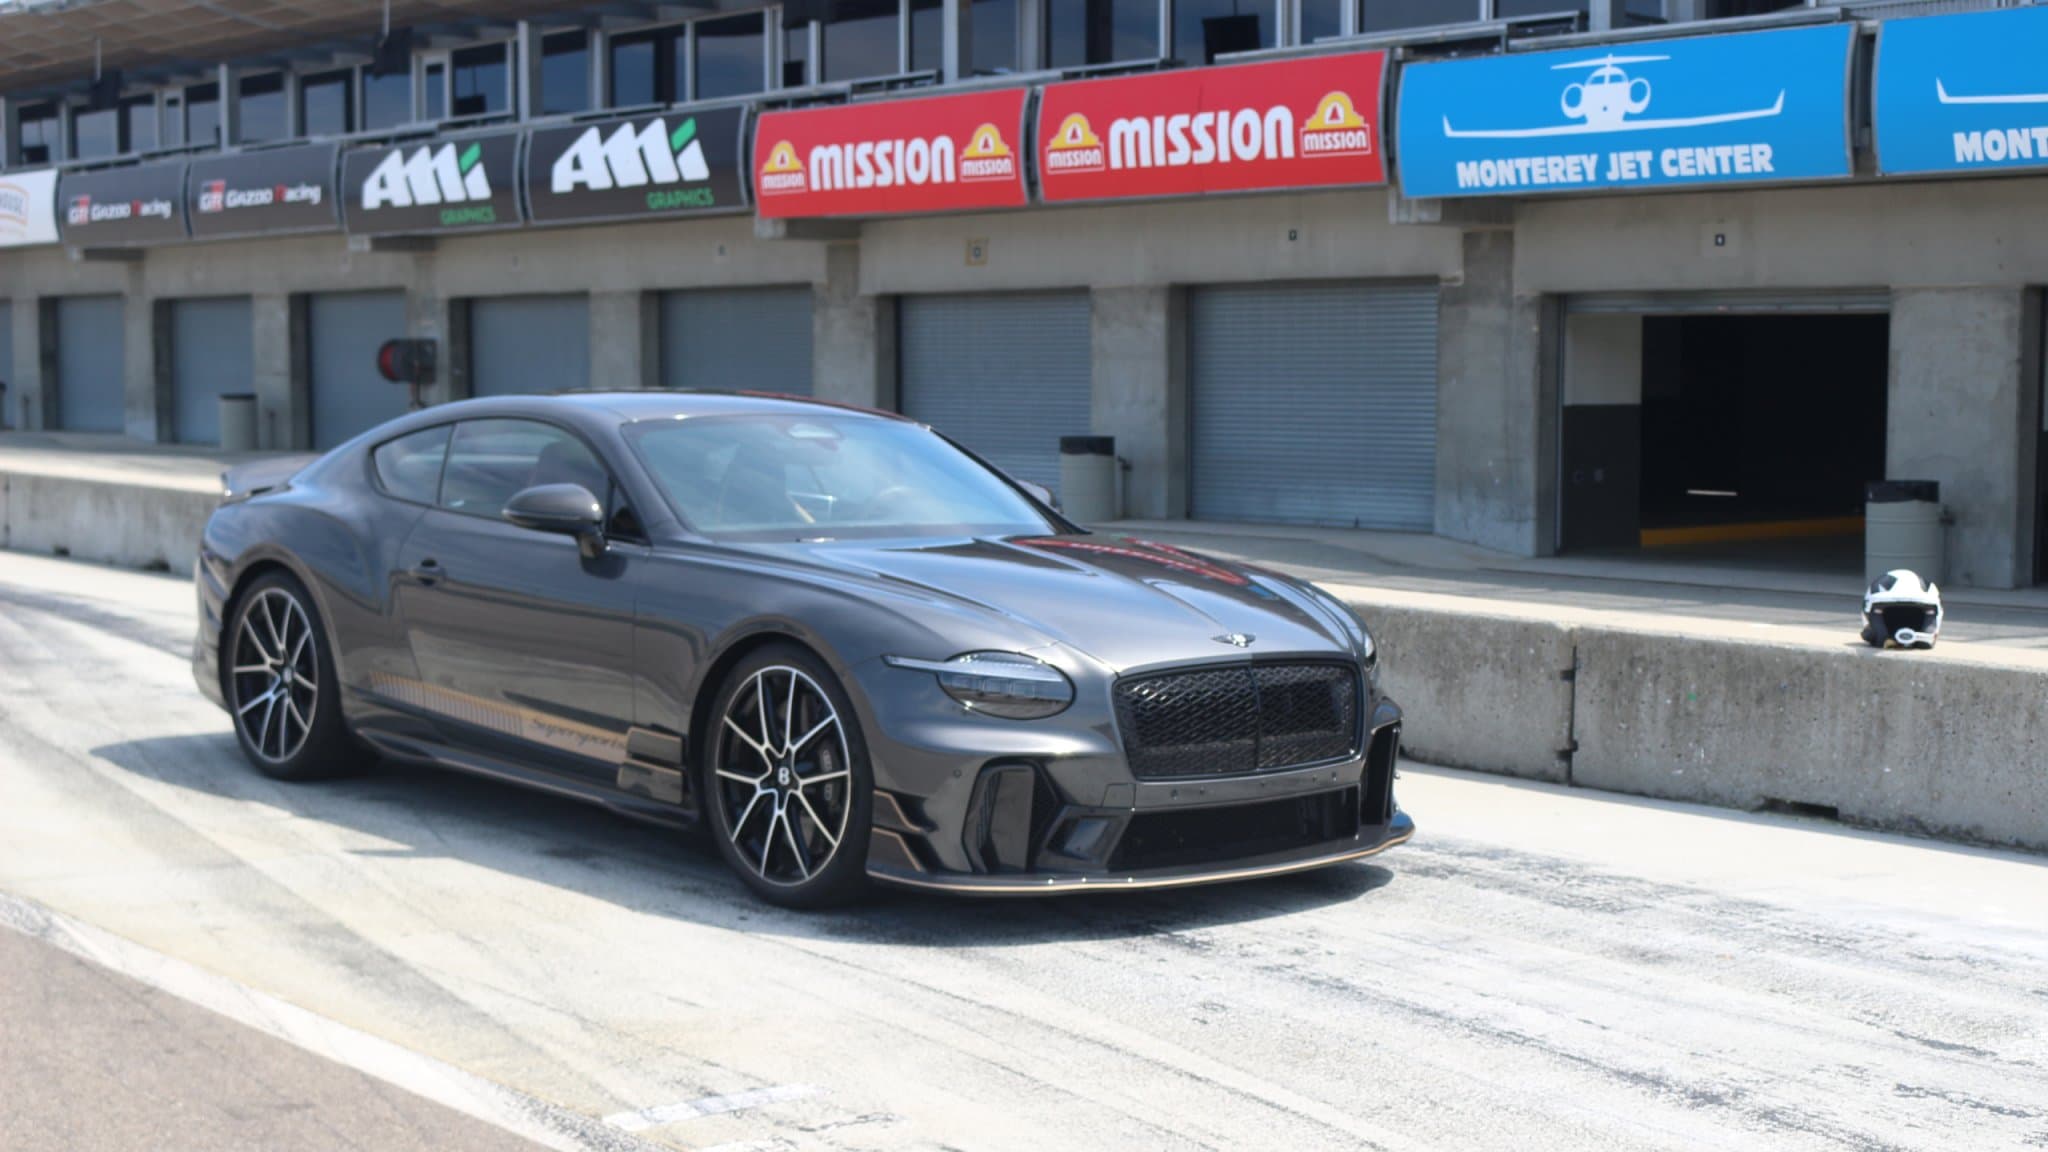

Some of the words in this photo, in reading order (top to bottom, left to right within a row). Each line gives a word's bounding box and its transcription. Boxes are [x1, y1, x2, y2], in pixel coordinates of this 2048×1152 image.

[1109, 105, 1295, 169] MISSION
[1304, 130, 1367, 153] MISSION
[809, 136, 955, 191] MISSION
[962, 158, 1012, 178] MISSION
[1049, 147, 1101, 169] MISSION
[1456, 154, 1598, 188] MONTEREY
[1606, 149, 1654, 180] JET
[1661, 143, 1774, 176] CENTER
[763, 171, 804, 189] MISSION
[274, 183, 321, 206] Racing
[646, 187, 714, 209] GRAPHICS
[440, 206, 495, 225] GRAPHICS
